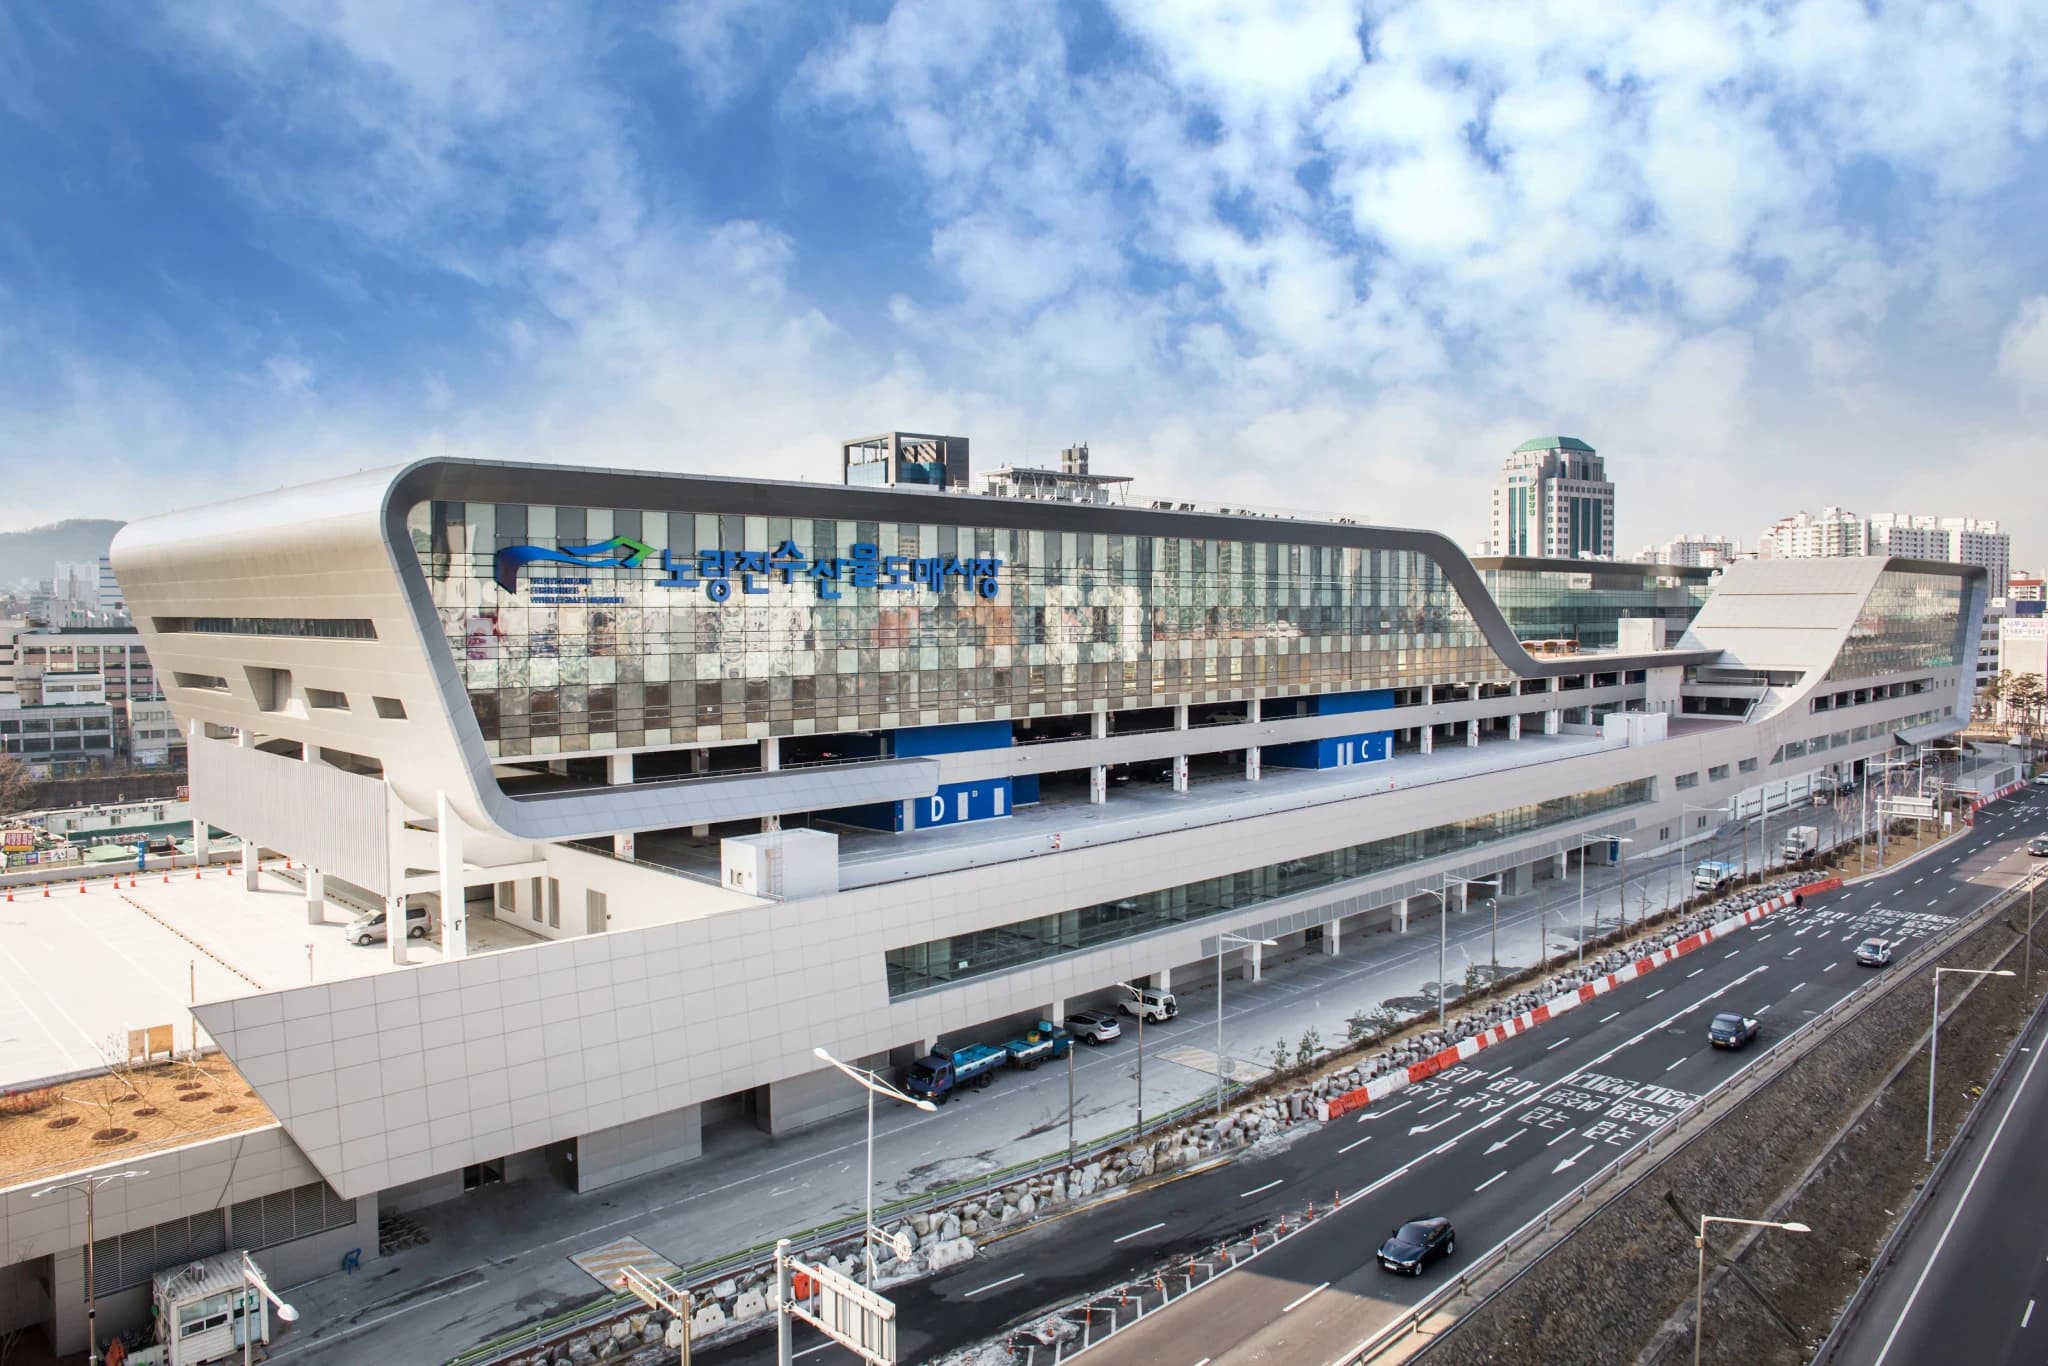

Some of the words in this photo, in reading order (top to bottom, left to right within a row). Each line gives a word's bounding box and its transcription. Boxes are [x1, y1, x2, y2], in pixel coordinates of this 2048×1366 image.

[655, 540, 1003, 602] 노량진수산물도매시장
[1361, 740, 1369, 759] C
[931, 796, 945, 822] D
[1486, 1077, 1541, 1096] 시장
[1581, 1120, 1637, 1146] 국립
